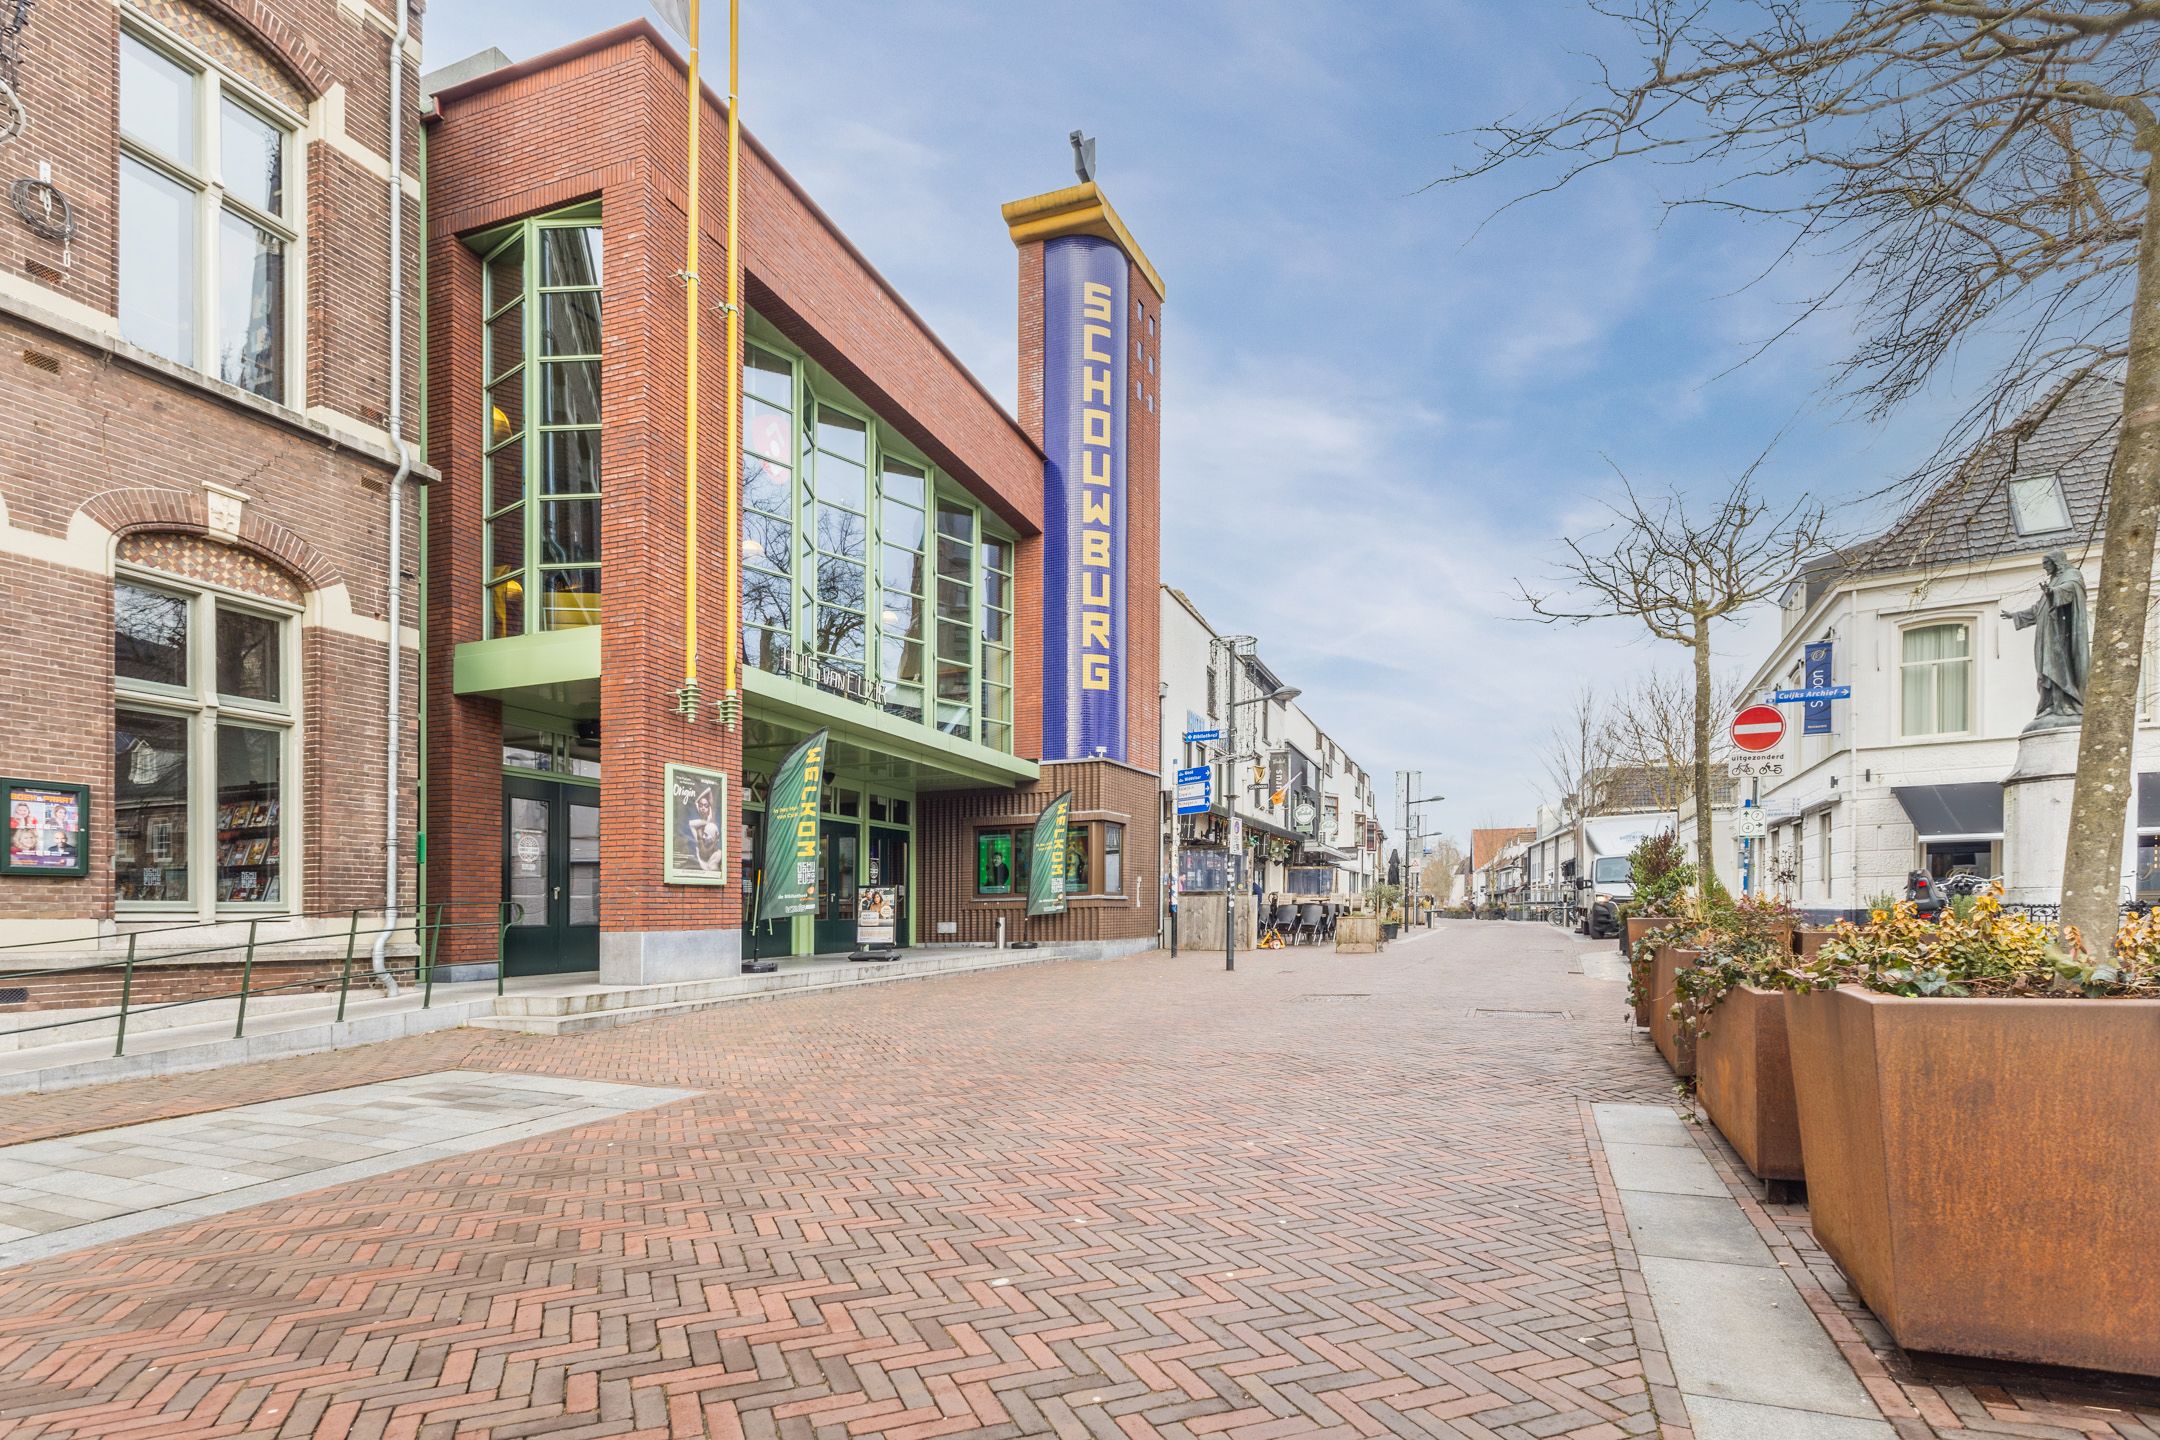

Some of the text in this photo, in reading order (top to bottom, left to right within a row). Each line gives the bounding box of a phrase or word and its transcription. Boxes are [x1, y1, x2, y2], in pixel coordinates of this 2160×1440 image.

[1081, 281, 1111, 691] SCHOUWBURG
[783, 647, 820, 682] HUIS
[1778, 688, 1838, 700] Cuijks Archief
[1731, 753, 1785, 762] uitgezonderd
[673, 783, 696, 805] Origin
[797, 746, 822, 857] WELKOM
[1051, 802, 1067, 876] WELKOM
